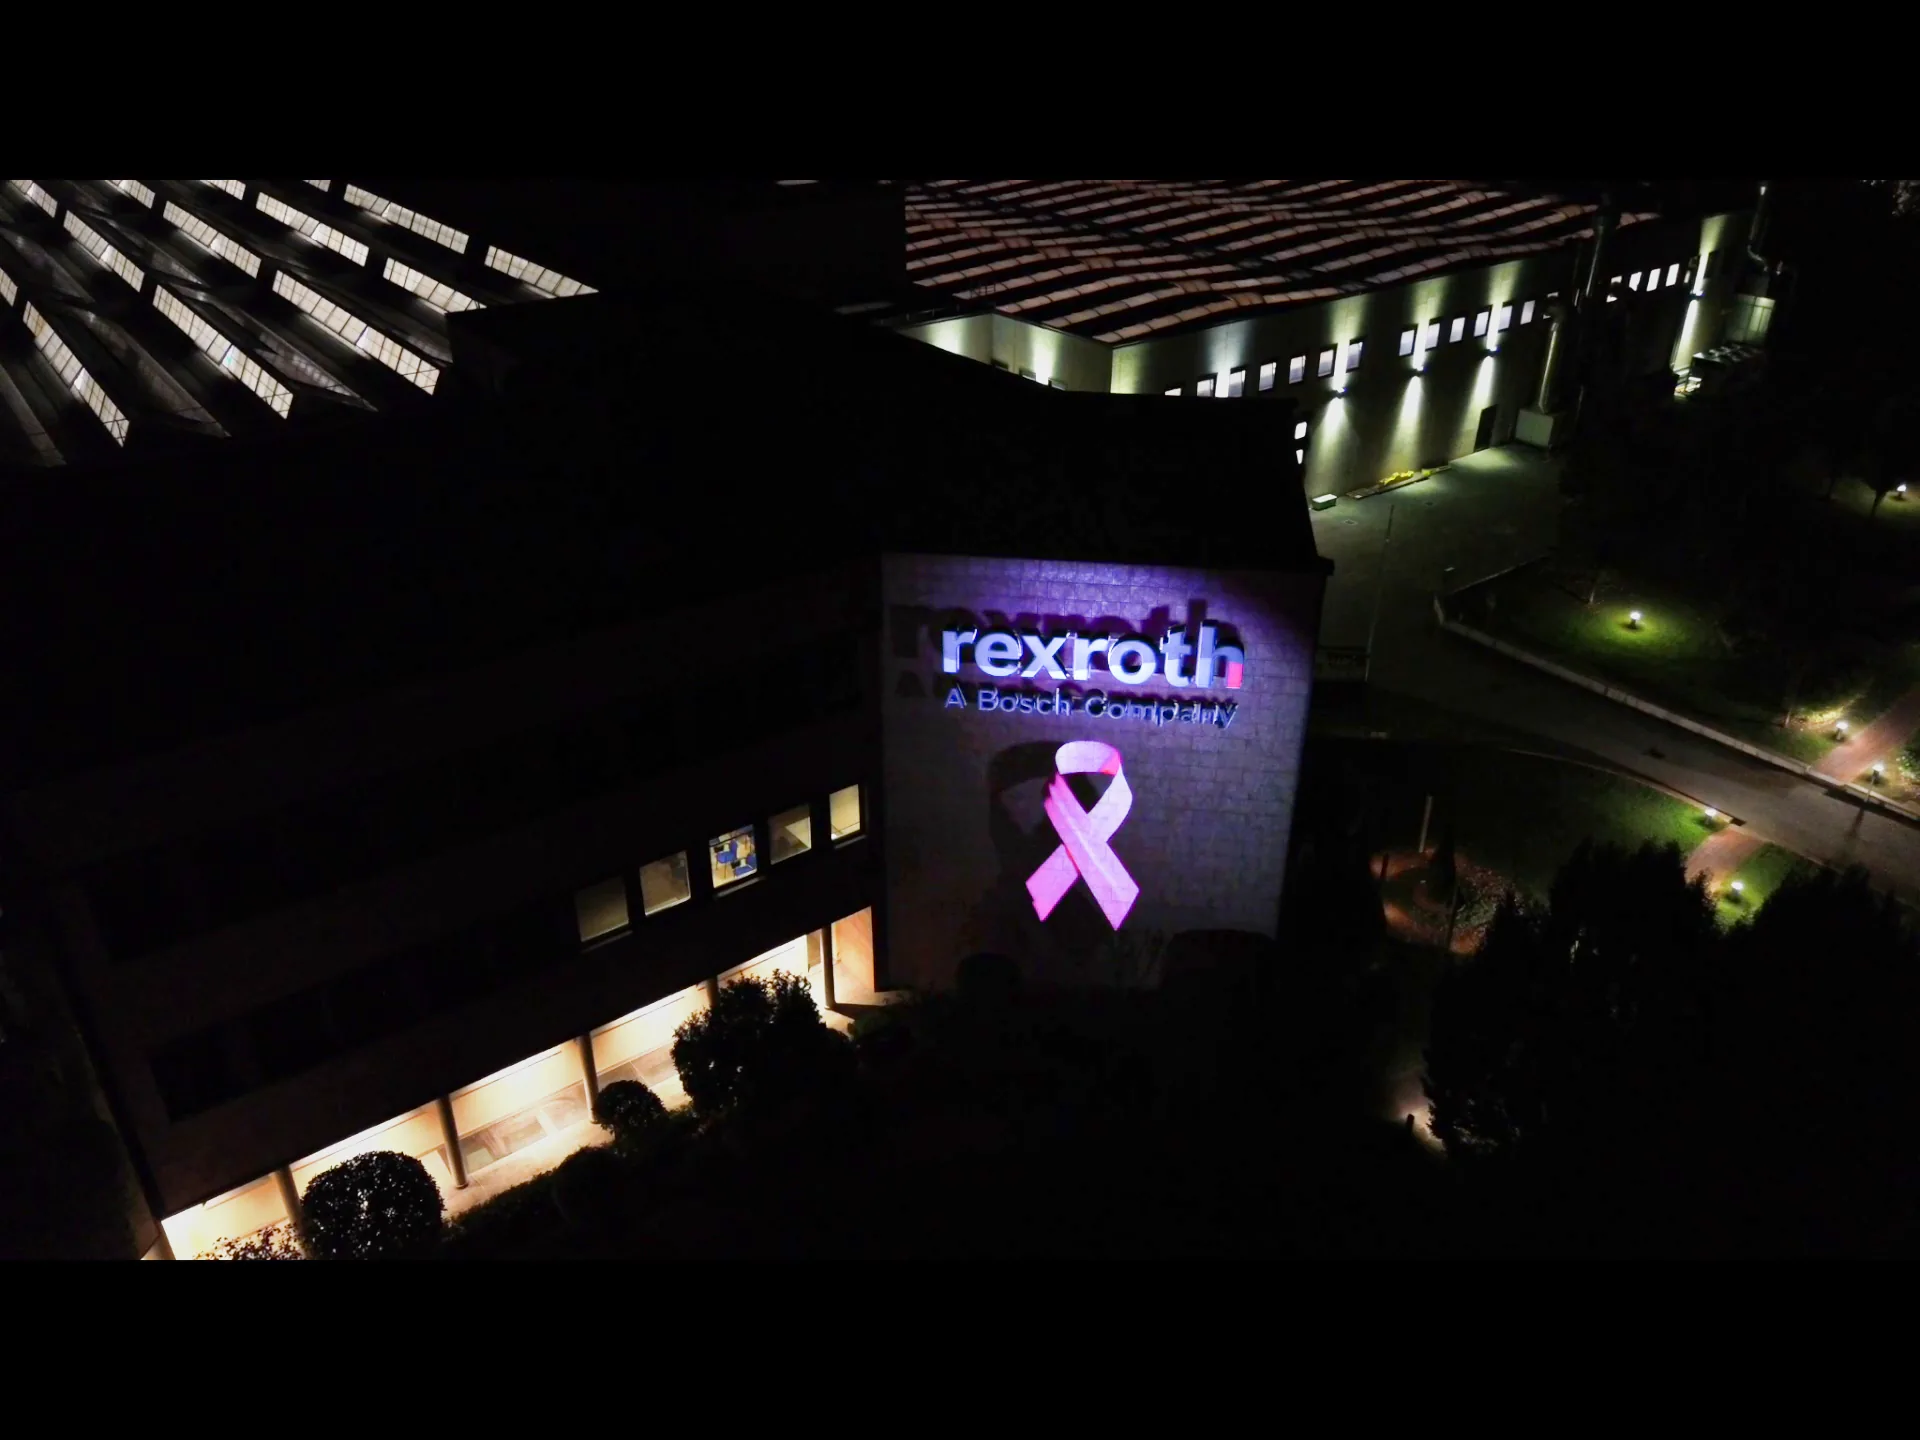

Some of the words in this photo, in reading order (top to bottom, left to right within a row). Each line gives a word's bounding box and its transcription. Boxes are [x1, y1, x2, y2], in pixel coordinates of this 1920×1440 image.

[942, 621, 1245, 689] rexroth
[944, 687, 968, 710] A
[978, 688, 1071, 716] Bosch
[1085, 694, 1239, 729] Company
